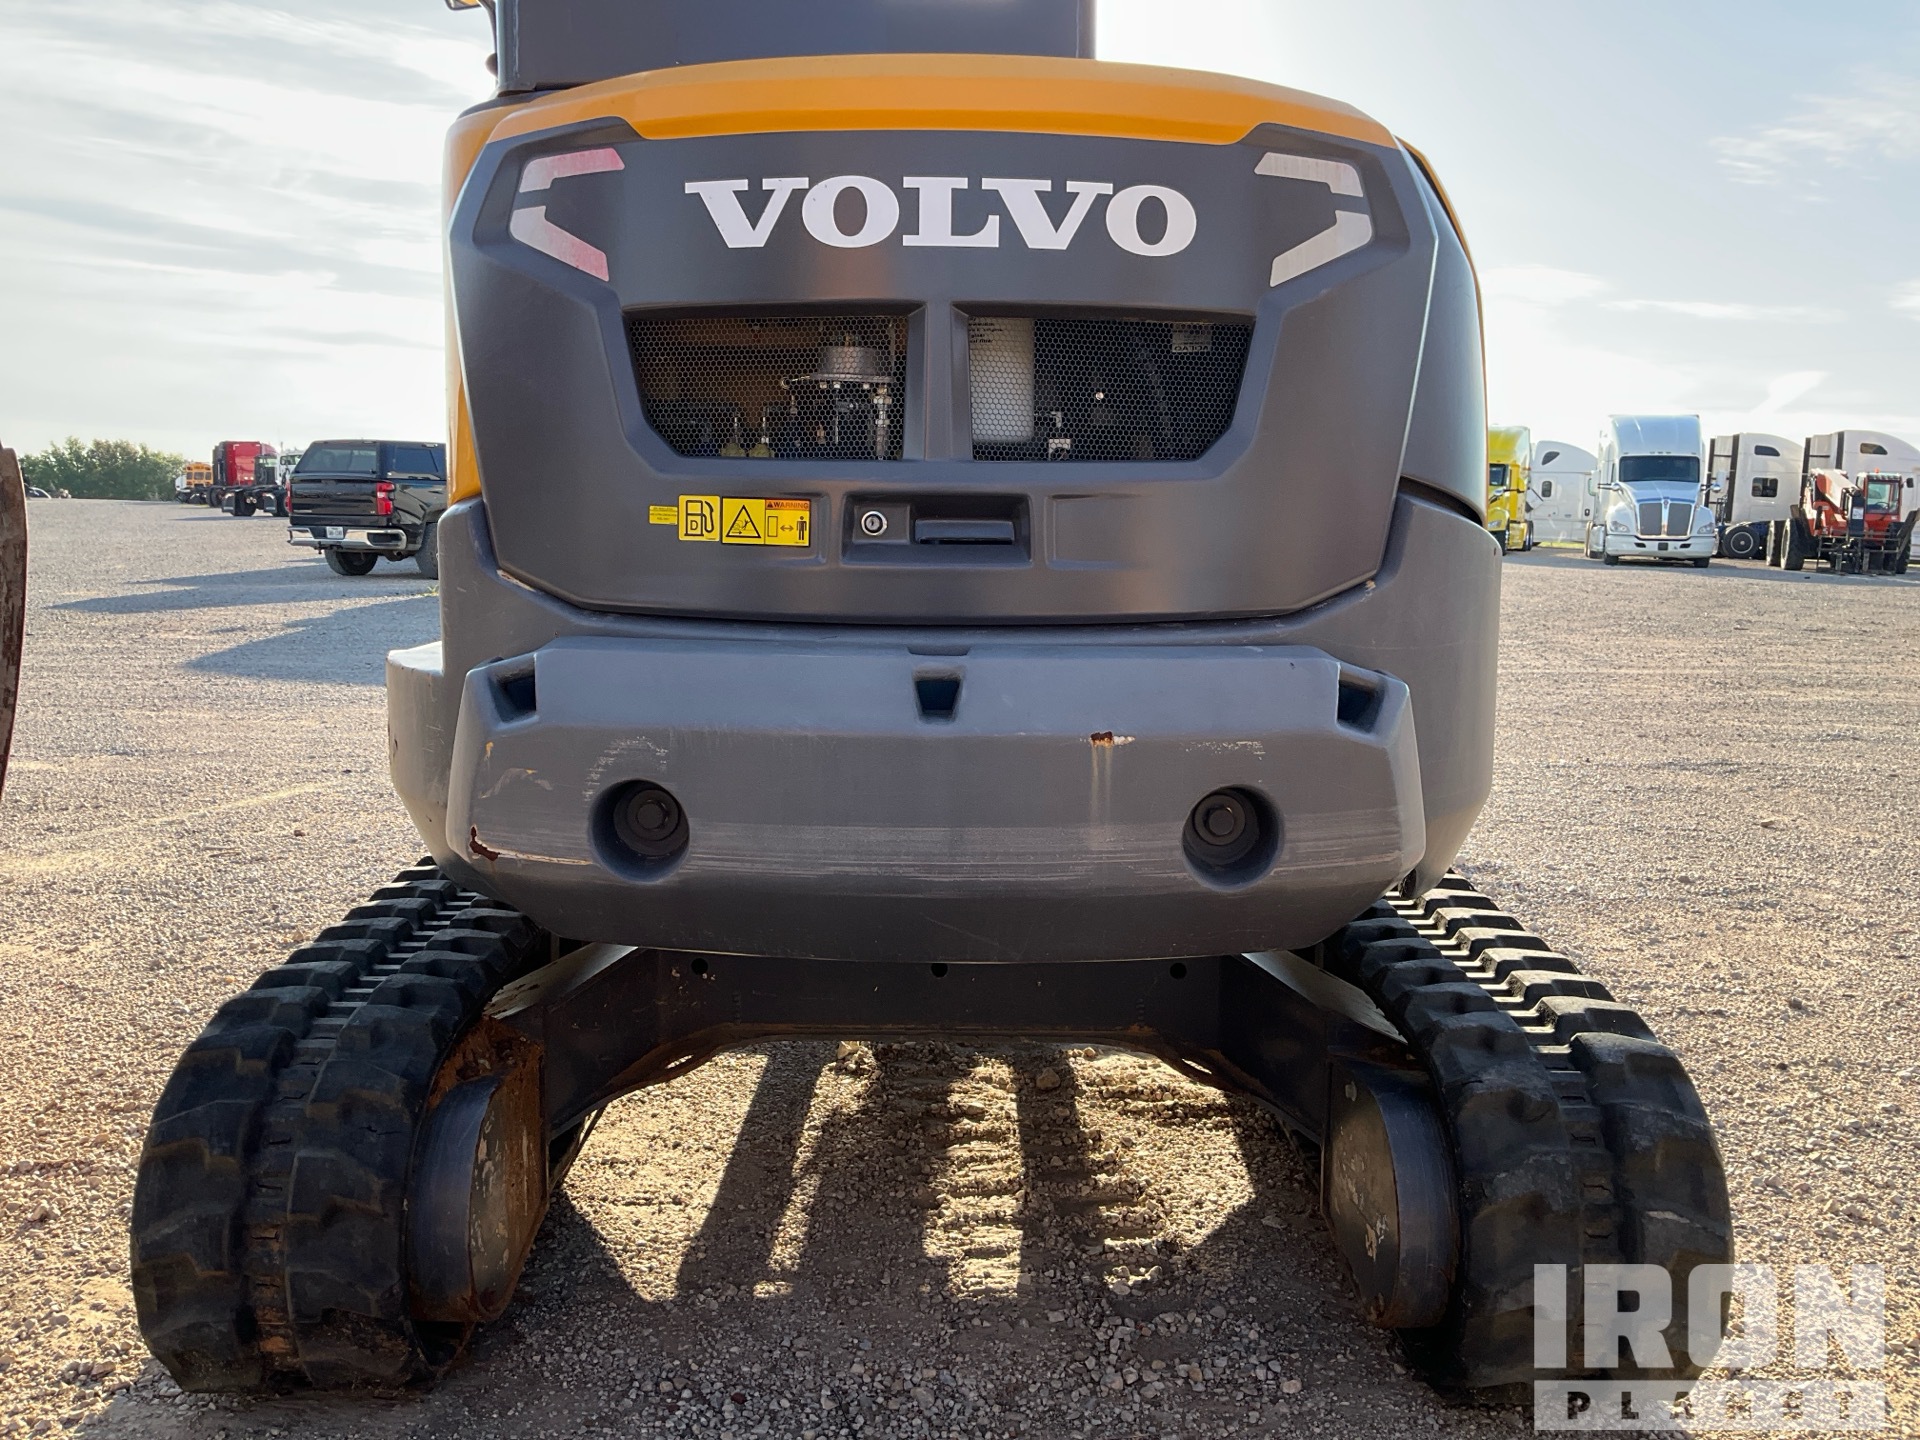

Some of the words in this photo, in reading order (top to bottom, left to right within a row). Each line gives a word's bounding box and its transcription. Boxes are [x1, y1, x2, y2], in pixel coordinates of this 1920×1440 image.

[685, 176, 1197, 256] VOLVO
[773, 501, 809, 509] WARNING
[690, 520, 698, 531] D
